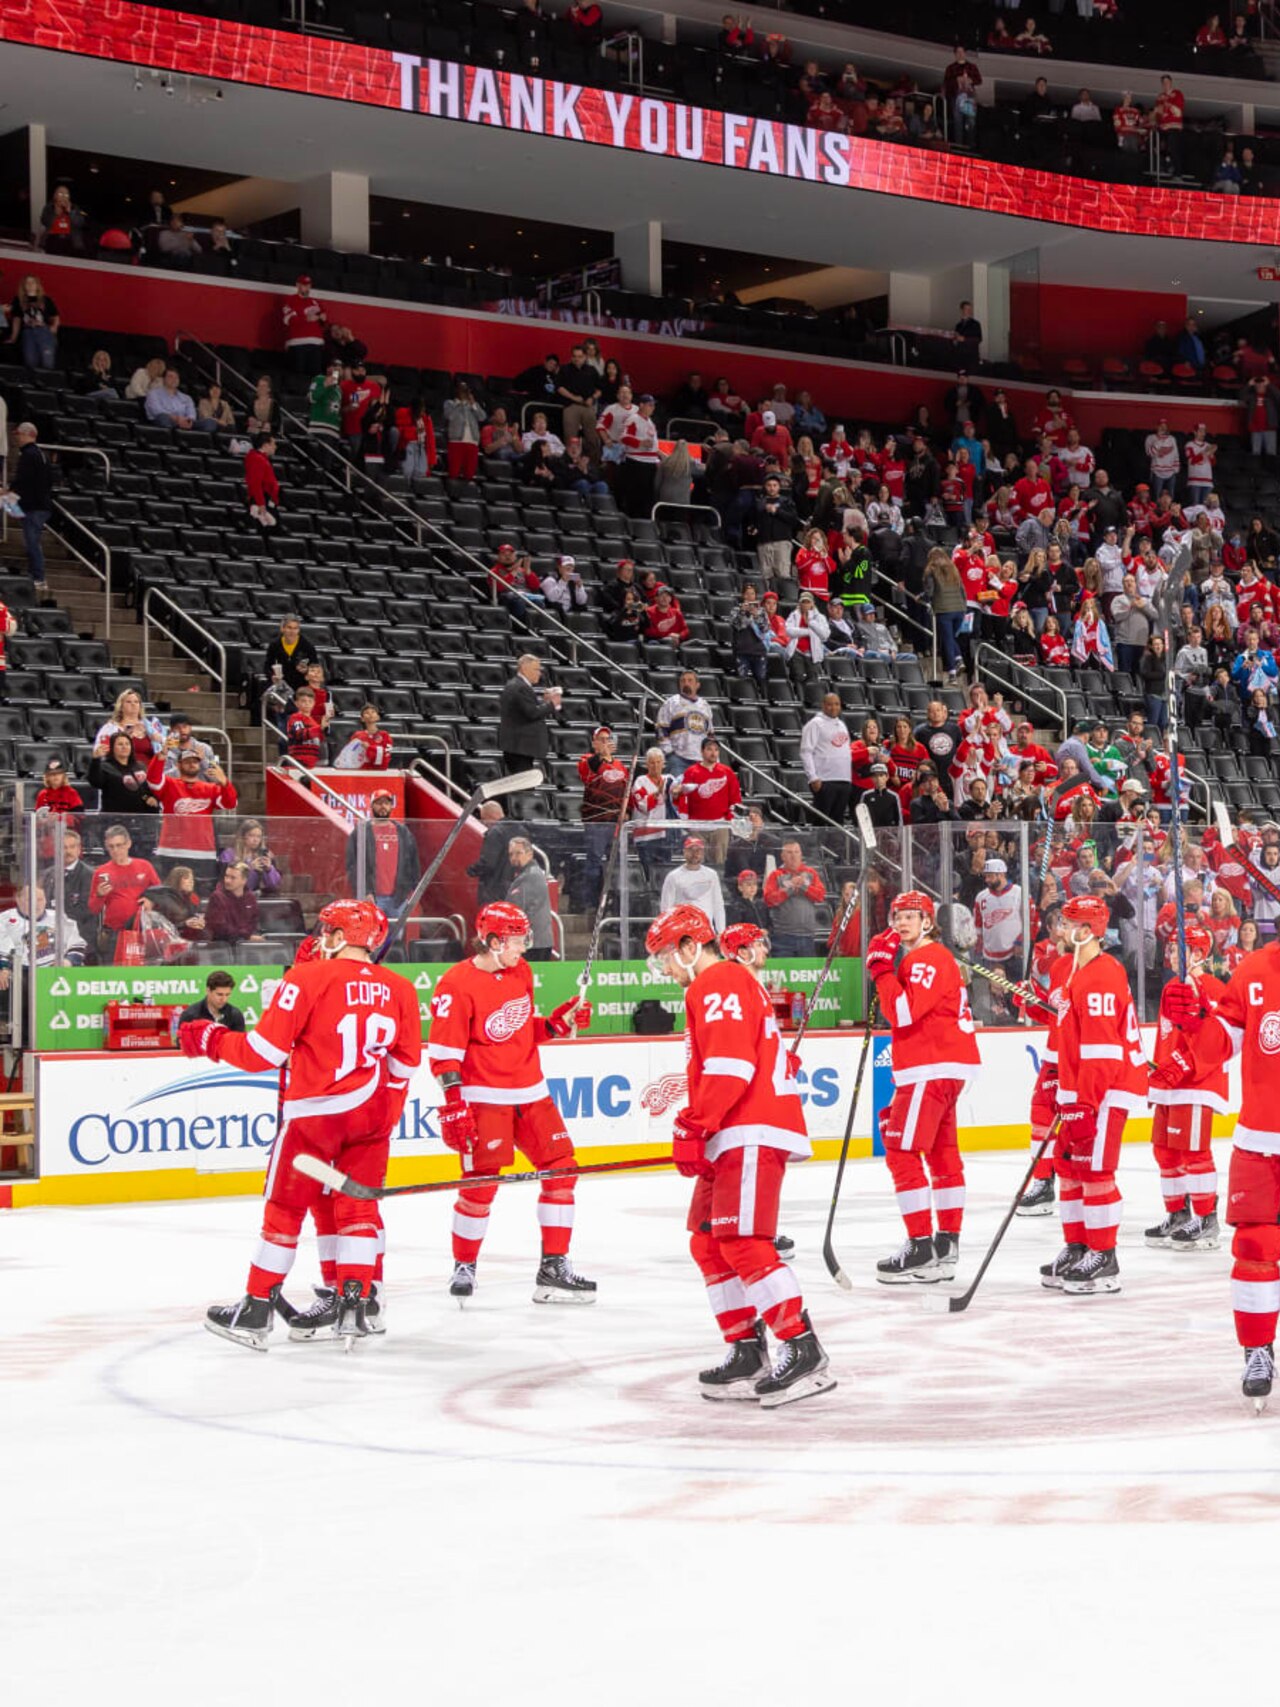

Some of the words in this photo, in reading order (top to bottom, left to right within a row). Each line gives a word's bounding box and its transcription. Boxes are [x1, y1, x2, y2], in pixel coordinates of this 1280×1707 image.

[392, 51, 584, 140] THANK
[604, 91, 703, 160] YOU
[724, 112, 850, 185] FANS
[77, 980, 129, 995] DELTA
[132, 979, 199, 995] DENTAL
[597, 972, 639, 986] DELTA
[910, 963, 936, 989] 53
[345, 981, 390, 1008] COPP
[1087, 992, 1116, 1017] 90
[1248, 982, 1264, 1006] C
[703, 993, 743, 1023] 24
[335, 1013, 397, 1081] 18
[69, 1112, 276, 1165] Comeric
